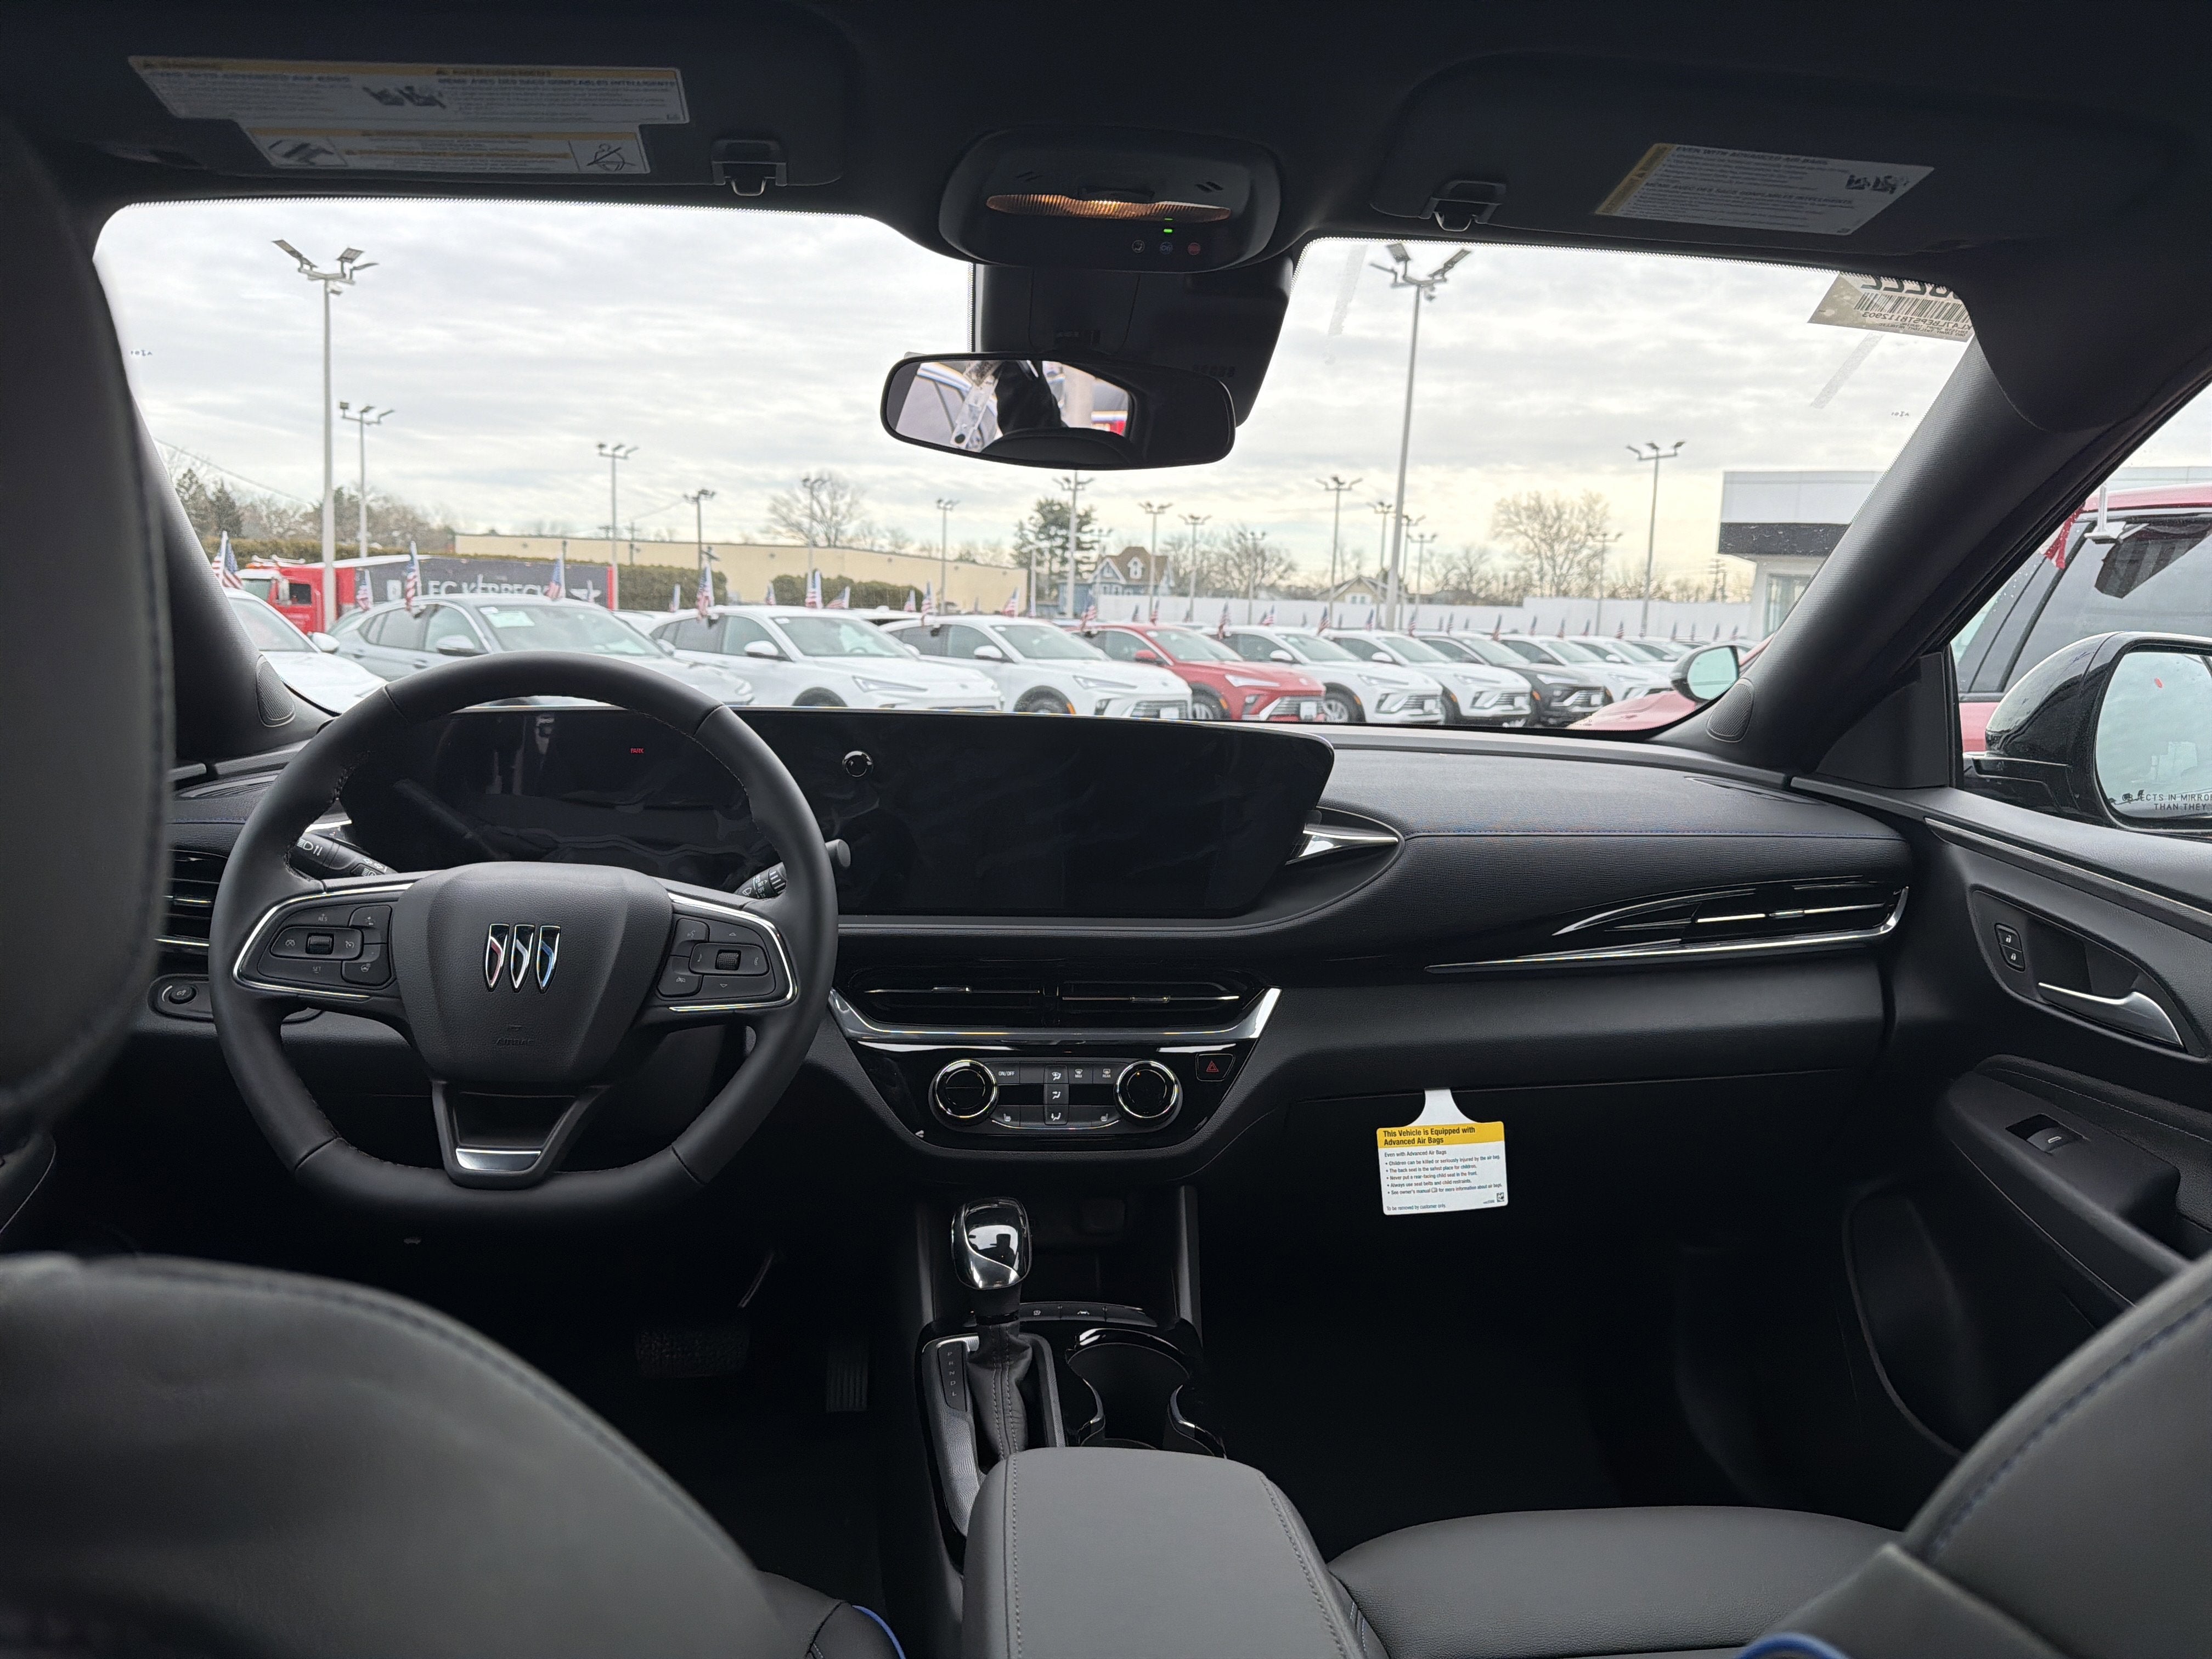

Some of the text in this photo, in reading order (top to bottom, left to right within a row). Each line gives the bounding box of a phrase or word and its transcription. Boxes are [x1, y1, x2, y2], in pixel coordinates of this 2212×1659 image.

[1399, 1128, 1421, 1137] Vehicle
[1431, 1127, 1460, 1136] Equipped
[1384, 1137, 1415, 1146] Advanced
[1428, 1136, 1444, 1144] Bags
